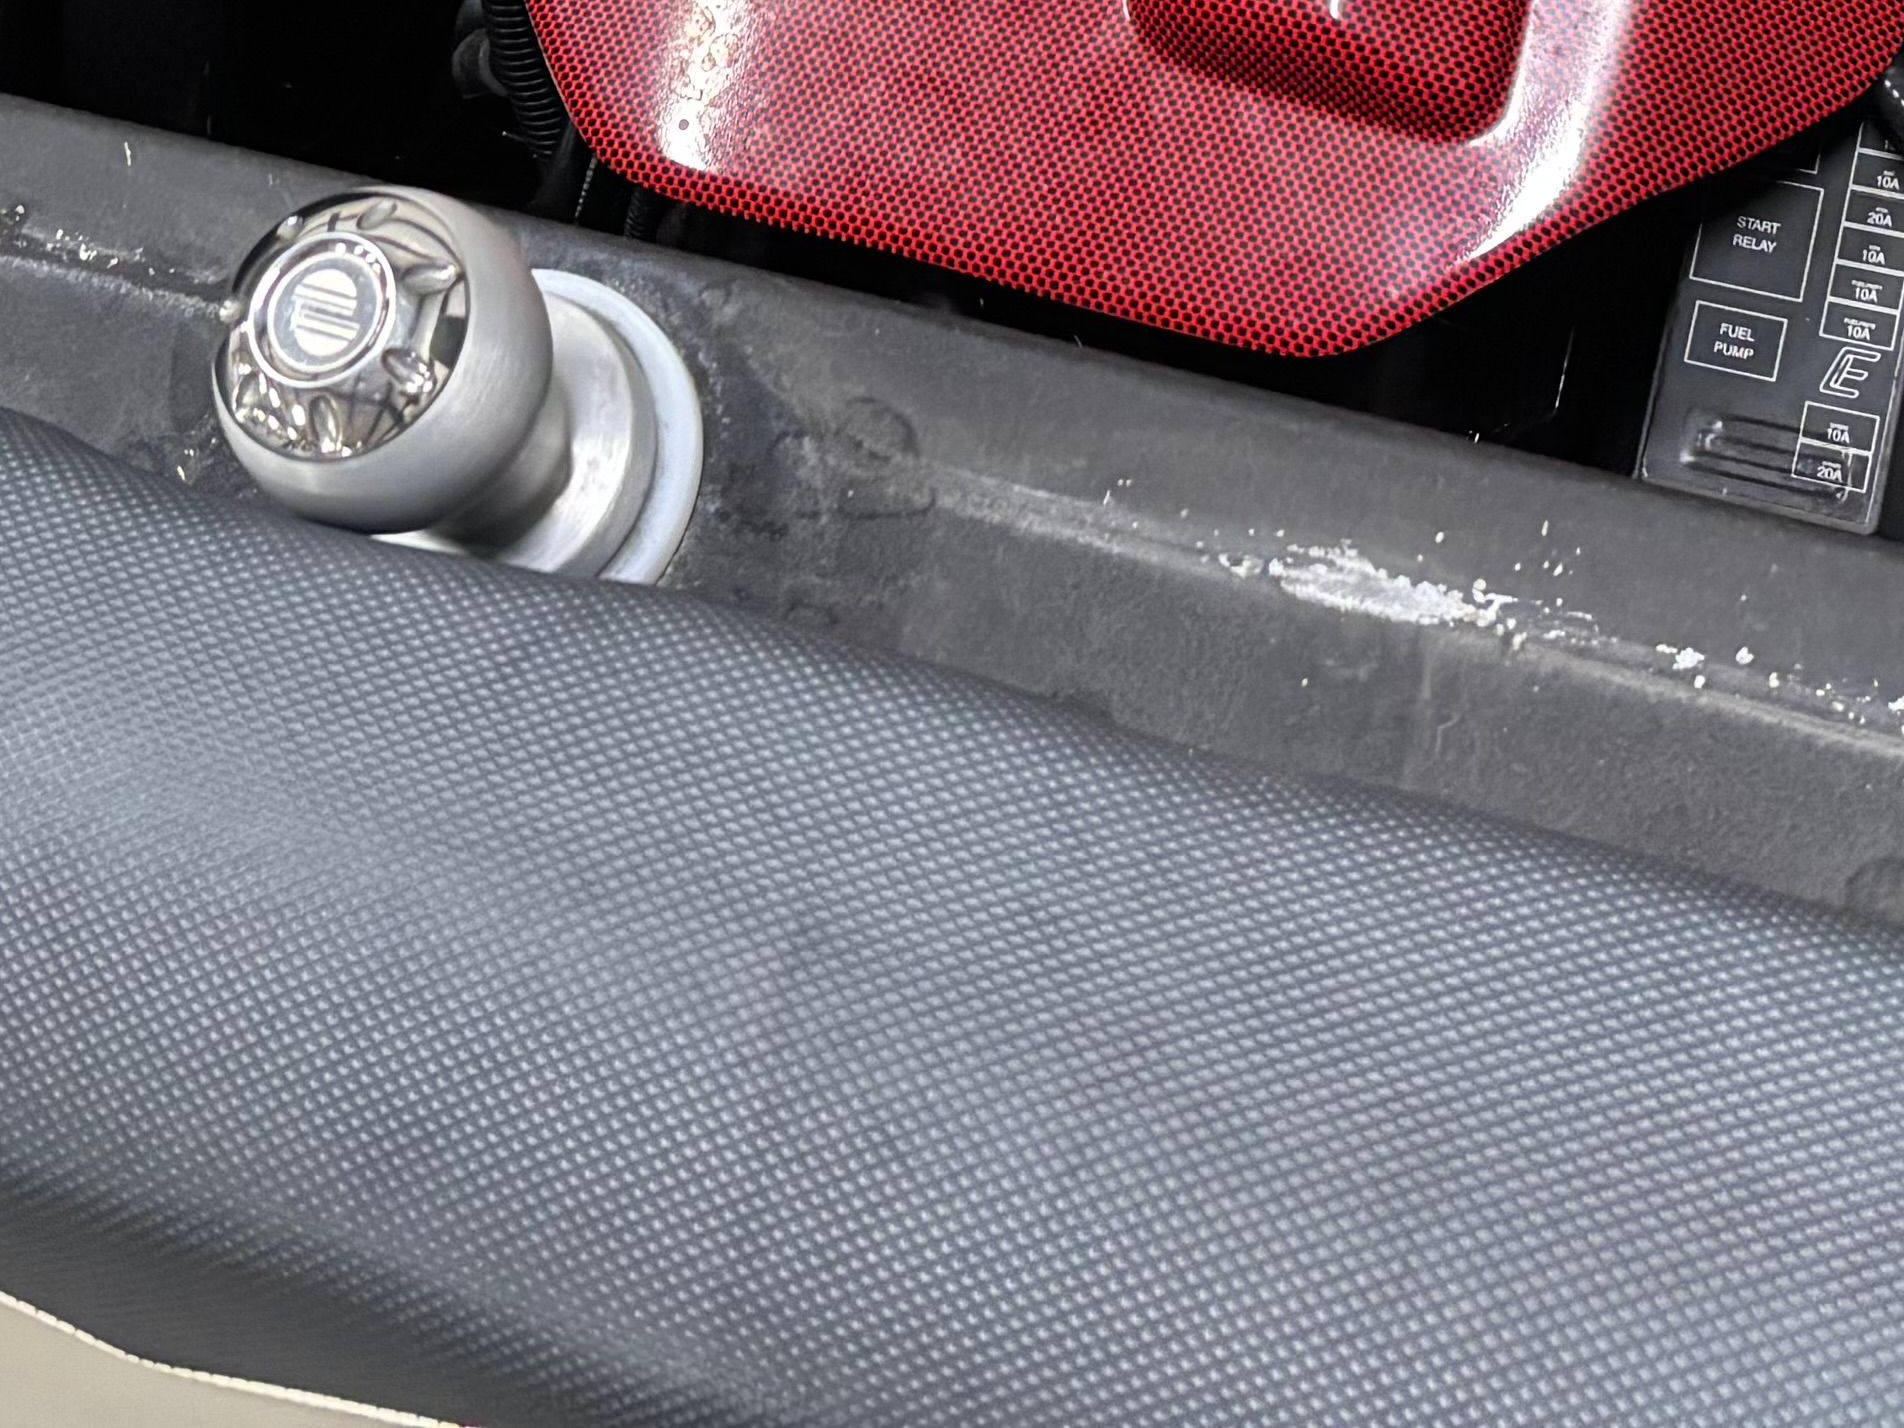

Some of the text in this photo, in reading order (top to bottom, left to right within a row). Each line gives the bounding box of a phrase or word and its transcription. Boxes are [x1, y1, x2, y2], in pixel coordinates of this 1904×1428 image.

[1876, 175, 1900, 190] 10A
[1737, 215, 1781, 234] START
[1866, 211, 1892, 228] 20A
[1732, 233, 1777, 253] RELAY
[1855, 287, 1878, 303] 10A
[1719, 322, 1755, 341] FUEL
[1846, 323, 1871, 343] 10A
[1713, 341, 1754, 360] PUMP
[1827, 427, 1850, 444] 10A
[1816, 465, 1844, 483] 20A
